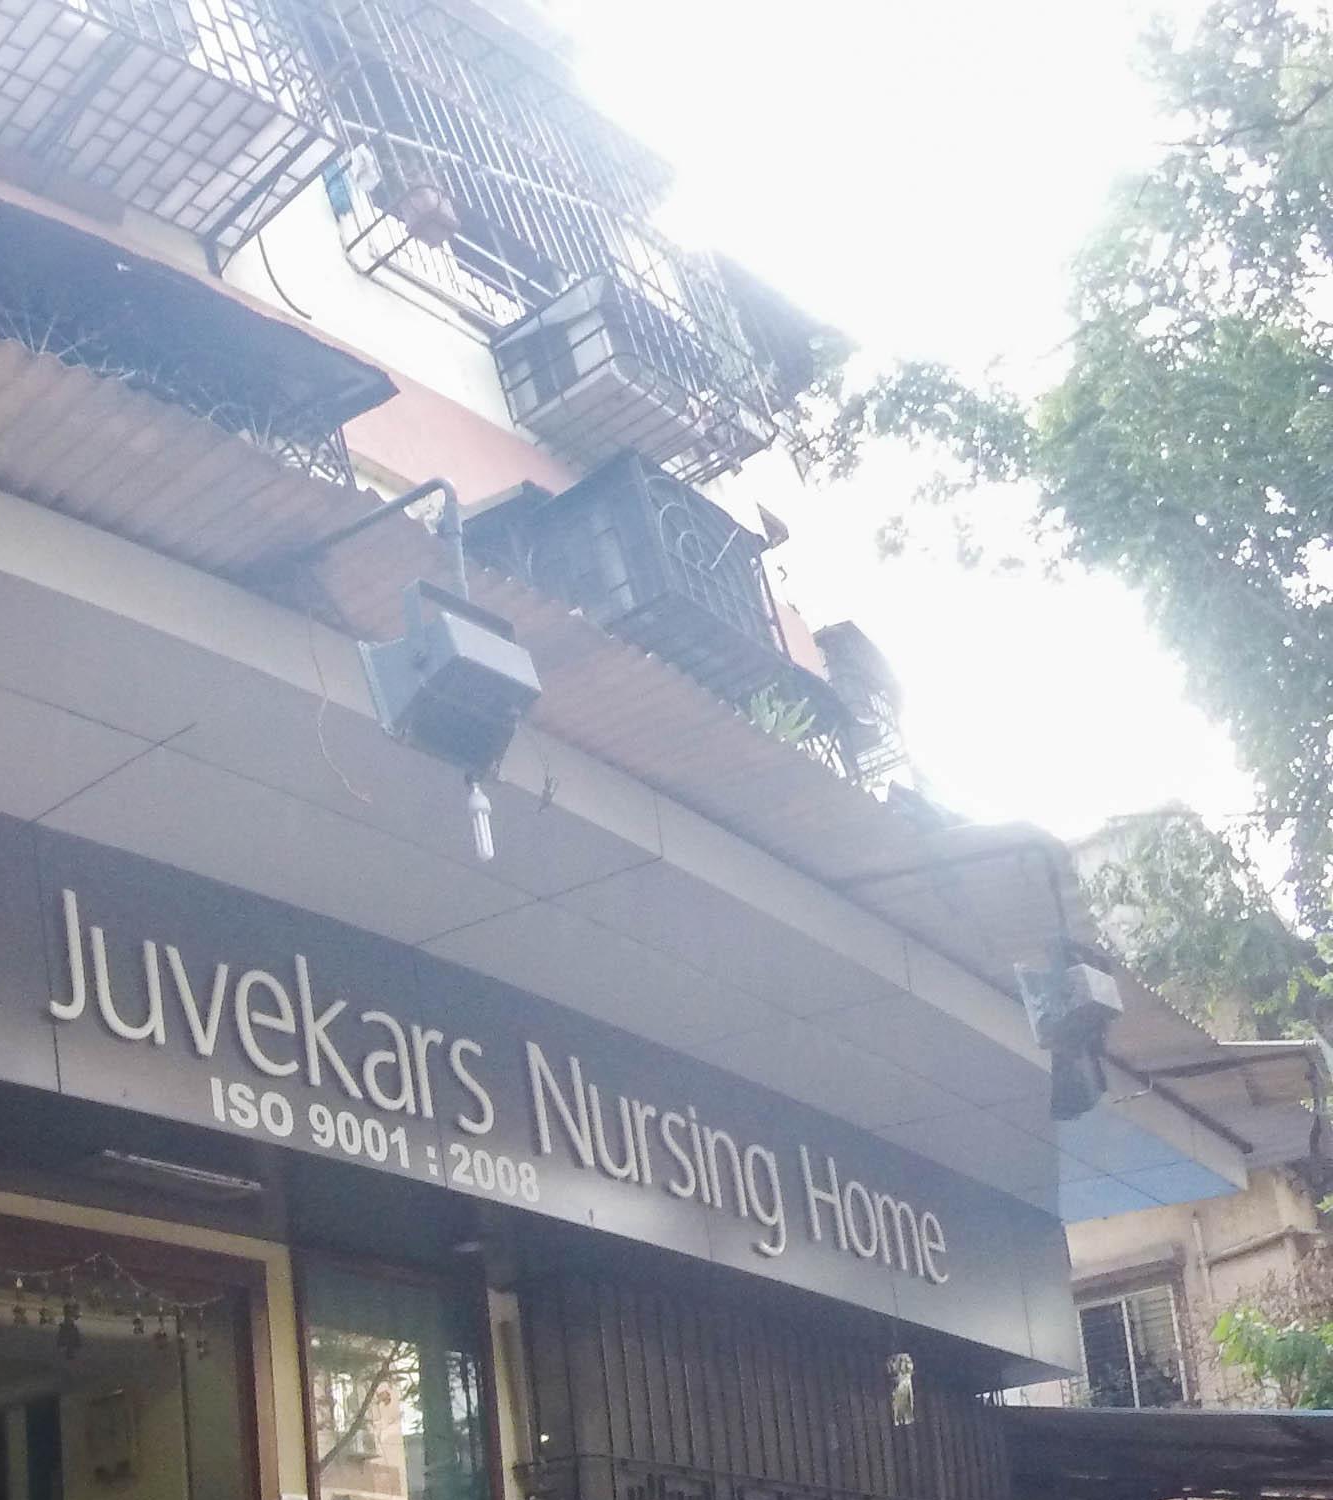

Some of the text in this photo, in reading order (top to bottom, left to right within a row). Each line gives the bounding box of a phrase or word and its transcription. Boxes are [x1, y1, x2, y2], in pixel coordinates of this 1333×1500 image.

[49, 887, 949, 1284] Juvekars Nursing Home
[210, 1076, 295, 1138] ISO
[307, 1101, 412, 1168] 9001
[448, 1143, 540, 1203] 2008
